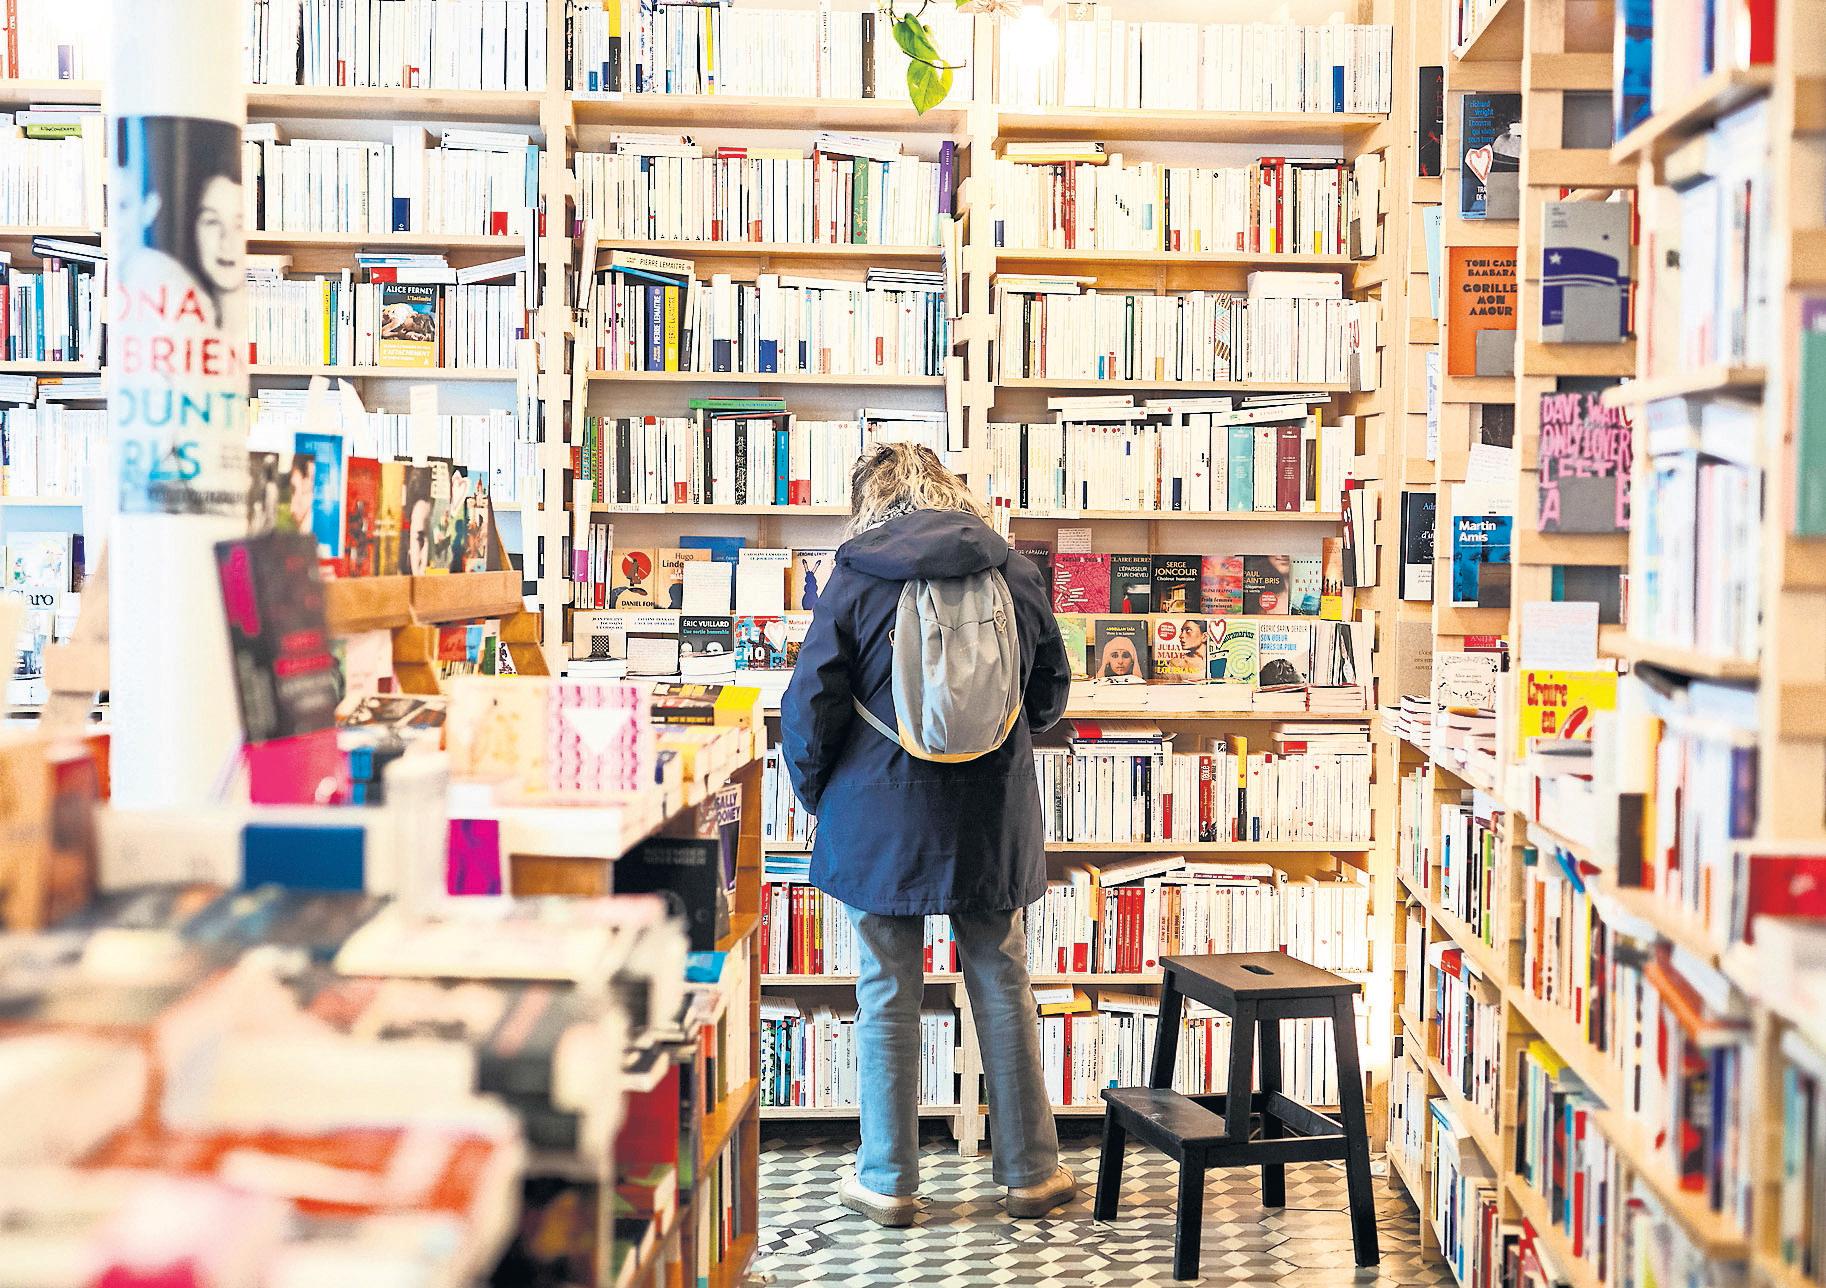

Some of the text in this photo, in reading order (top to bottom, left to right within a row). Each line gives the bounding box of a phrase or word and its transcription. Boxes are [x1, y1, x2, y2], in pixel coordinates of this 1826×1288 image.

[386, 286, 434, 295] ALICE FERNEY
[1462, 284, 1518, 292] GORILLE
[1476, 295, 1506, 304] MON
[1469, 306, 1512, 316] AMOUR
[1458, 520, 1496, 531] Martin
[1458, 532, 1488, 542] Amis
[675, 553, 694, 561] Hugo
[1154, 568, 1198, 576] JONCOUR
[682, 618, 730, 628] ÉRIC VUILLARD
